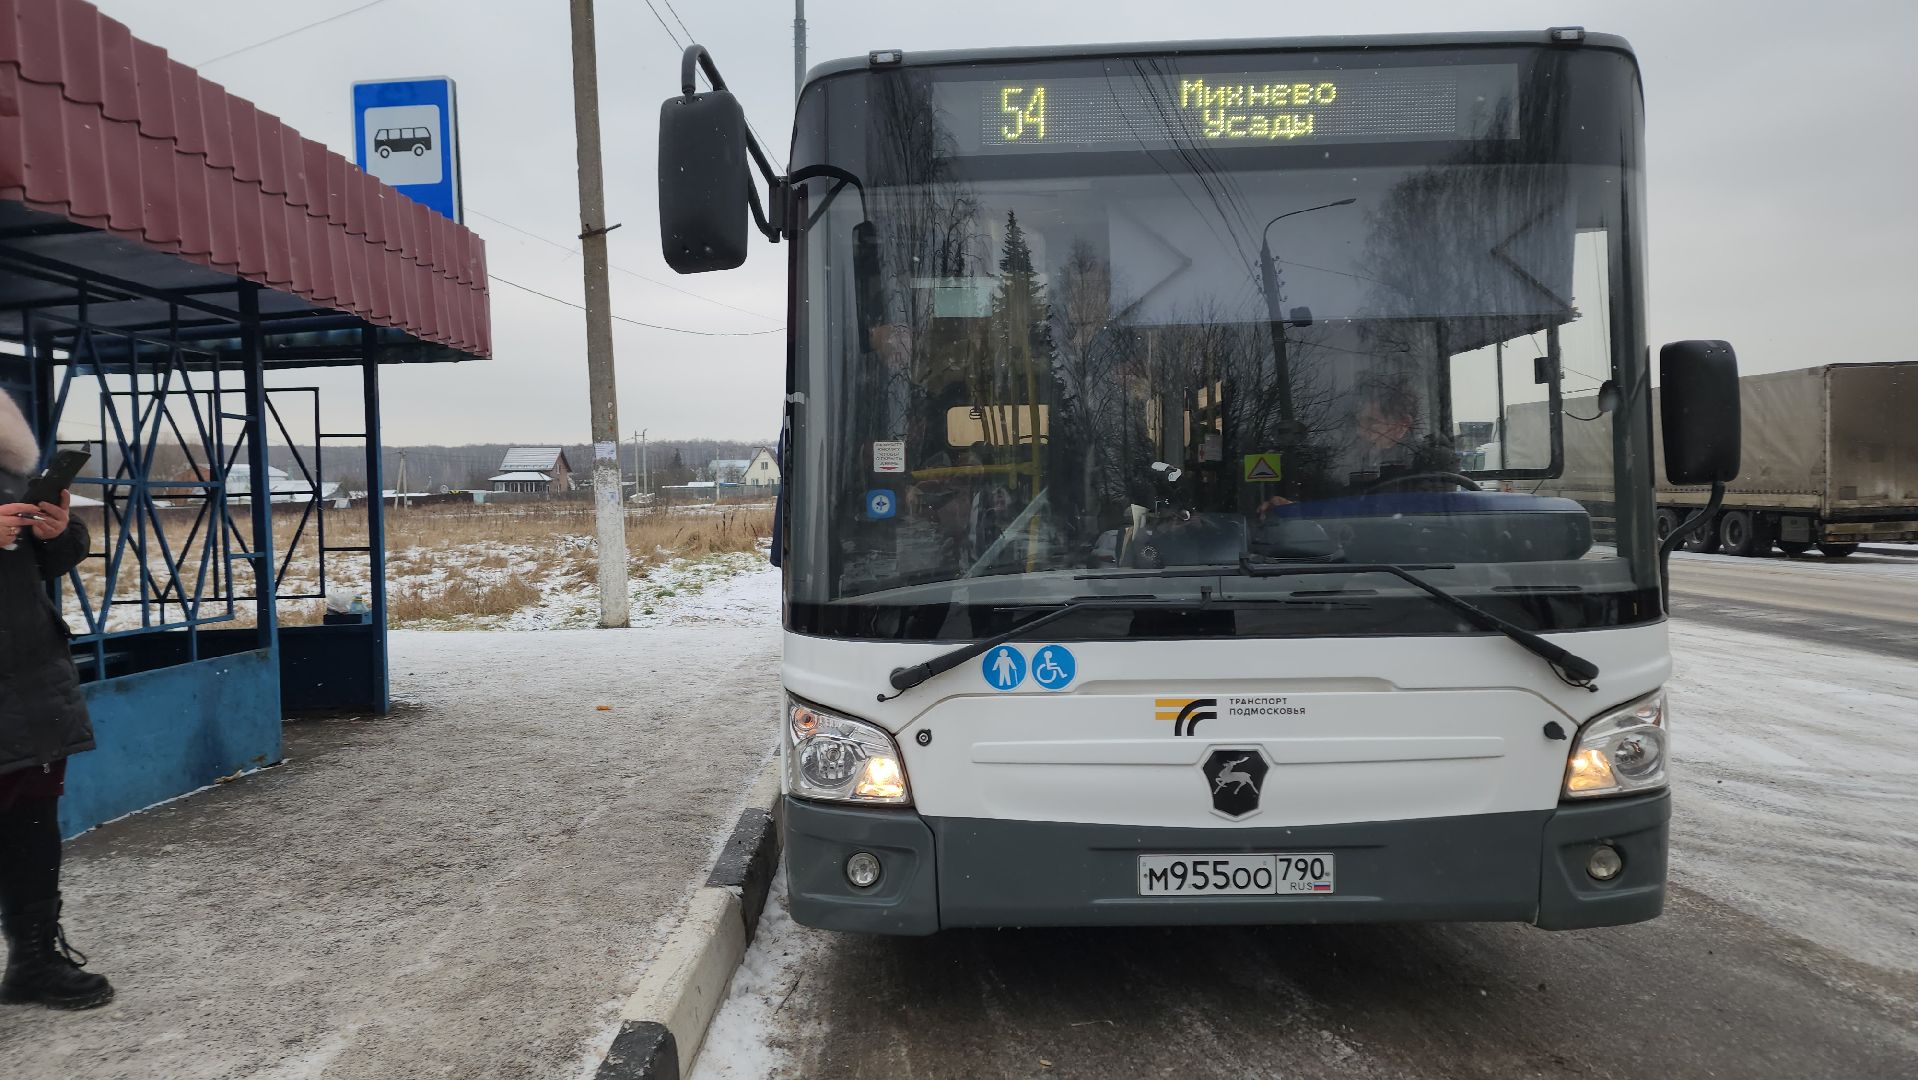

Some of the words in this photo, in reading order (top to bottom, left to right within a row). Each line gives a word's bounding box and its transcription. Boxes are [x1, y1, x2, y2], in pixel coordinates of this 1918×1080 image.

[1180, 79, 1337, 108] Михнево
[1000, 86, 1046, 141] 54
[1203, 109, 1315, 140] Усады
[1229, 707, 1306, 716] ПОДМОСКОВЬЯ
[1278, 857, 1325, 880] 790
[1290, 881, 1313, 890] RUS
